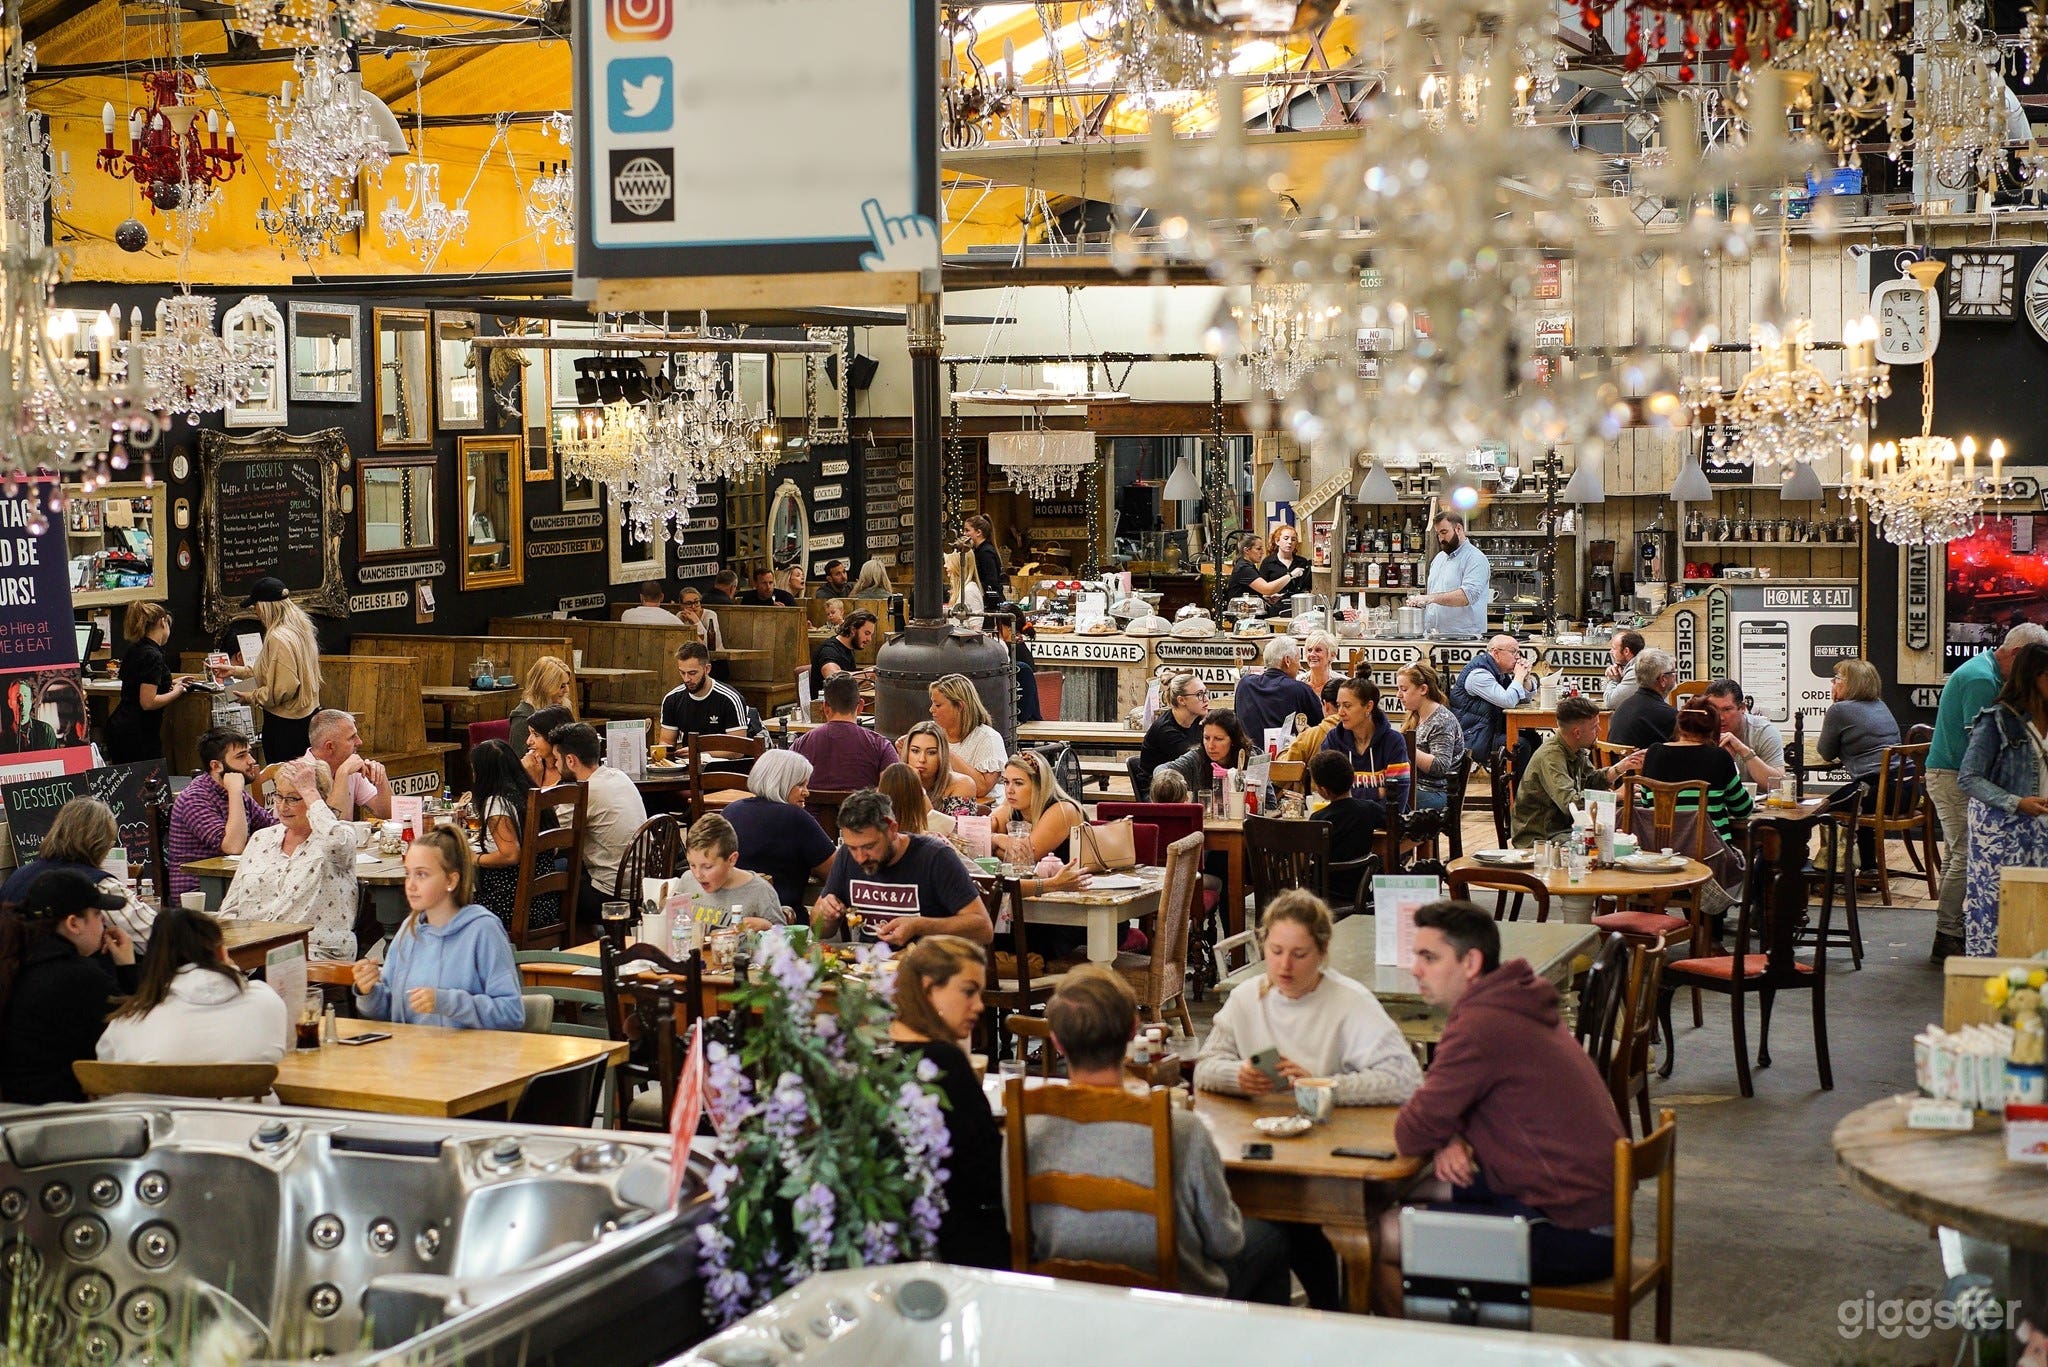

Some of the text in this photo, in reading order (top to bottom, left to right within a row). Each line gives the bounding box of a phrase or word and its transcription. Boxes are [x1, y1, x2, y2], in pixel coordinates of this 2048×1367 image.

[1360, 278, 1383, 288] CLOSE
[1535, 285, 1558, 296] EER
[1900, 292, 1911, 301] 12
[1884, 307, 1893, 317] 10
[1537, 320, 1565, 332] Beer
[1884, 327, 1892, 337] 8
[1369, 330, 1380, 339] NO
[1902, 342, 1909, 351] 6
[245, 462, 284, 480] DESSERTS
[822, 462, 848, 474] PROSECCO
[1296, 470, 1351, 517] PROSECCO
[0, 499, 41, 528] TAGE
[1035, 504, 1084, 515] HOGWARTS
[532, 514, 600, 529] MANCHESTER CITY FC
[1030, 529, 1049, 538] GIN
[17, 538, 40, 567] BE
[530, 543, 561, 556] OXFORD
[561, 540, 589, 553] STREET
[679, 544, 717, 557] GOODISON PARK
[360, 562, 444, 581] MANCHESTER UNITED FC
[679, 566, 695, 578] UPTON
[695, 564, 708, 576] PARK
[1767, 590, 1849, 605] H@ME & EAT
[1910, 545, 1927, 642] THE EMIRAT
[351, 594, 392, 611] CHELSEA
[560, 596, 605, 610] THE EMIRATES
[1711, 598, 1725, 621] ALL
[10, 621, 35, 635] Hire
[37, 621, 49, 634] at
[28, 636, 53, 652] EAT
[1158, 645, 1255, 656] STAMFORD BRIDGE SW6
[1679, 618, 1692, 684] CHELSE
[1711, 626, 1725, 661] ROAD
[1030, 644, 1137, 659] FALGAR SQUARE
[1550, 651, 1613, 666] ARSENA
[1801, 690, 1831, 700] ORDE
[410, 774, 437, 792] ROAD
[12, 781, 75, 811] DESSERTS
